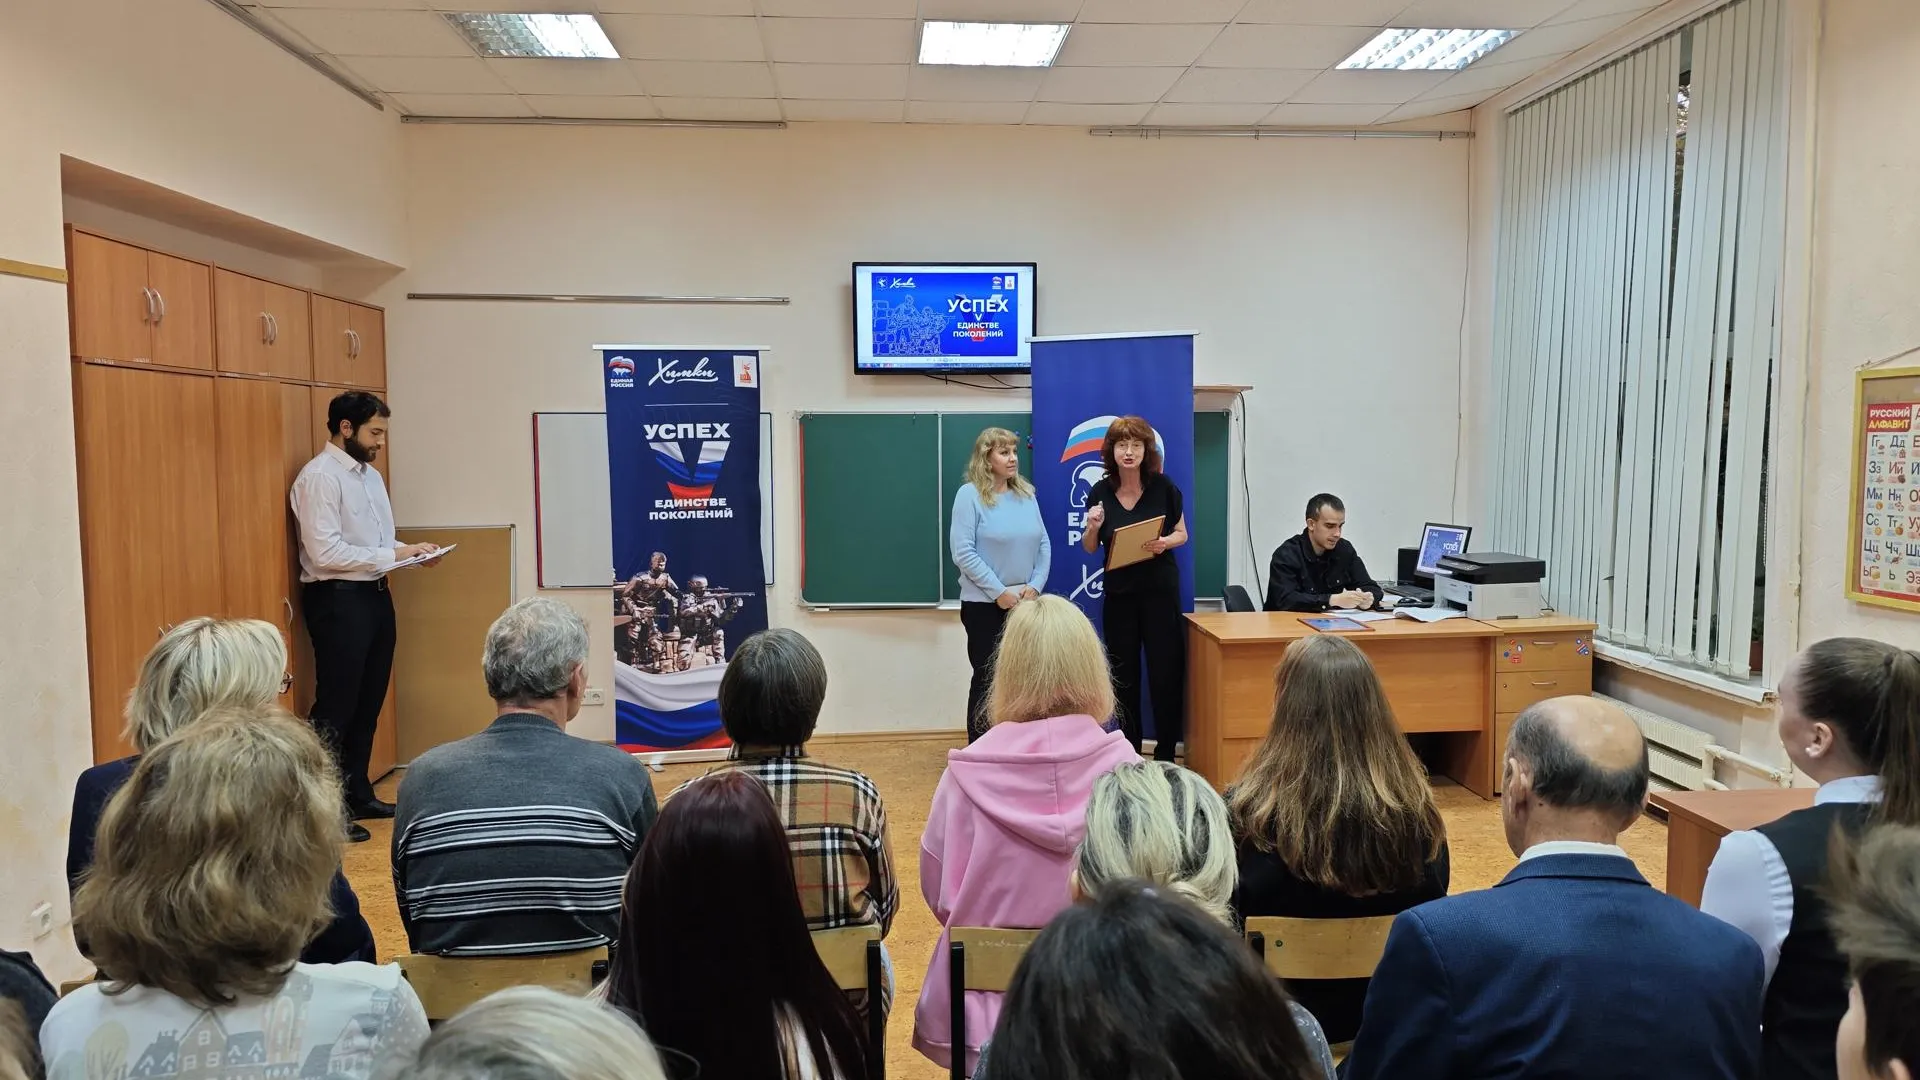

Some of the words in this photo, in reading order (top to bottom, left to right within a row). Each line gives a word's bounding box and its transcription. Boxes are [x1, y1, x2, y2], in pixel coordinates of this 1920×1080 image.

[947, 299, 1009, 313] УСПЕХ
[975, 313, 983, 321] V
[957, 322, 1000, 330] ЕДИНСТВЕ
[953, 330, 1004, 338] ПОКОЛЕНИЙ
[648, 357, 719, 386] Химки
[1870, 406, 1911, 418] РУССКИЙ
[1868, 419, 1910, 429] АЛФАВИТ
[643, 423, 730, 439] УСПЕХ
[1871, 435, 1881, 448] Гг
[1890, 435, 1906, 448] Дд
[1912, 435, 1920, 448] Е
[1869, 461, 1881, 474] Зз
[1889, 461, 1904, 475] Ии
[1866, 487, 1883, 501] Мм
[1888, 488, 1902, 502] Нн
[1909, 489, 1920, 503] О
[654, 498, 727, 508] ЕДИНСТВЕ
[649, 508, 733, 520] ПОКОЛЕНИЙ
[1865, 513, 1880, 526] Сс
[1887, 514, 1898, 528] Тт
[1885, 541, 1899, 555] Чч
